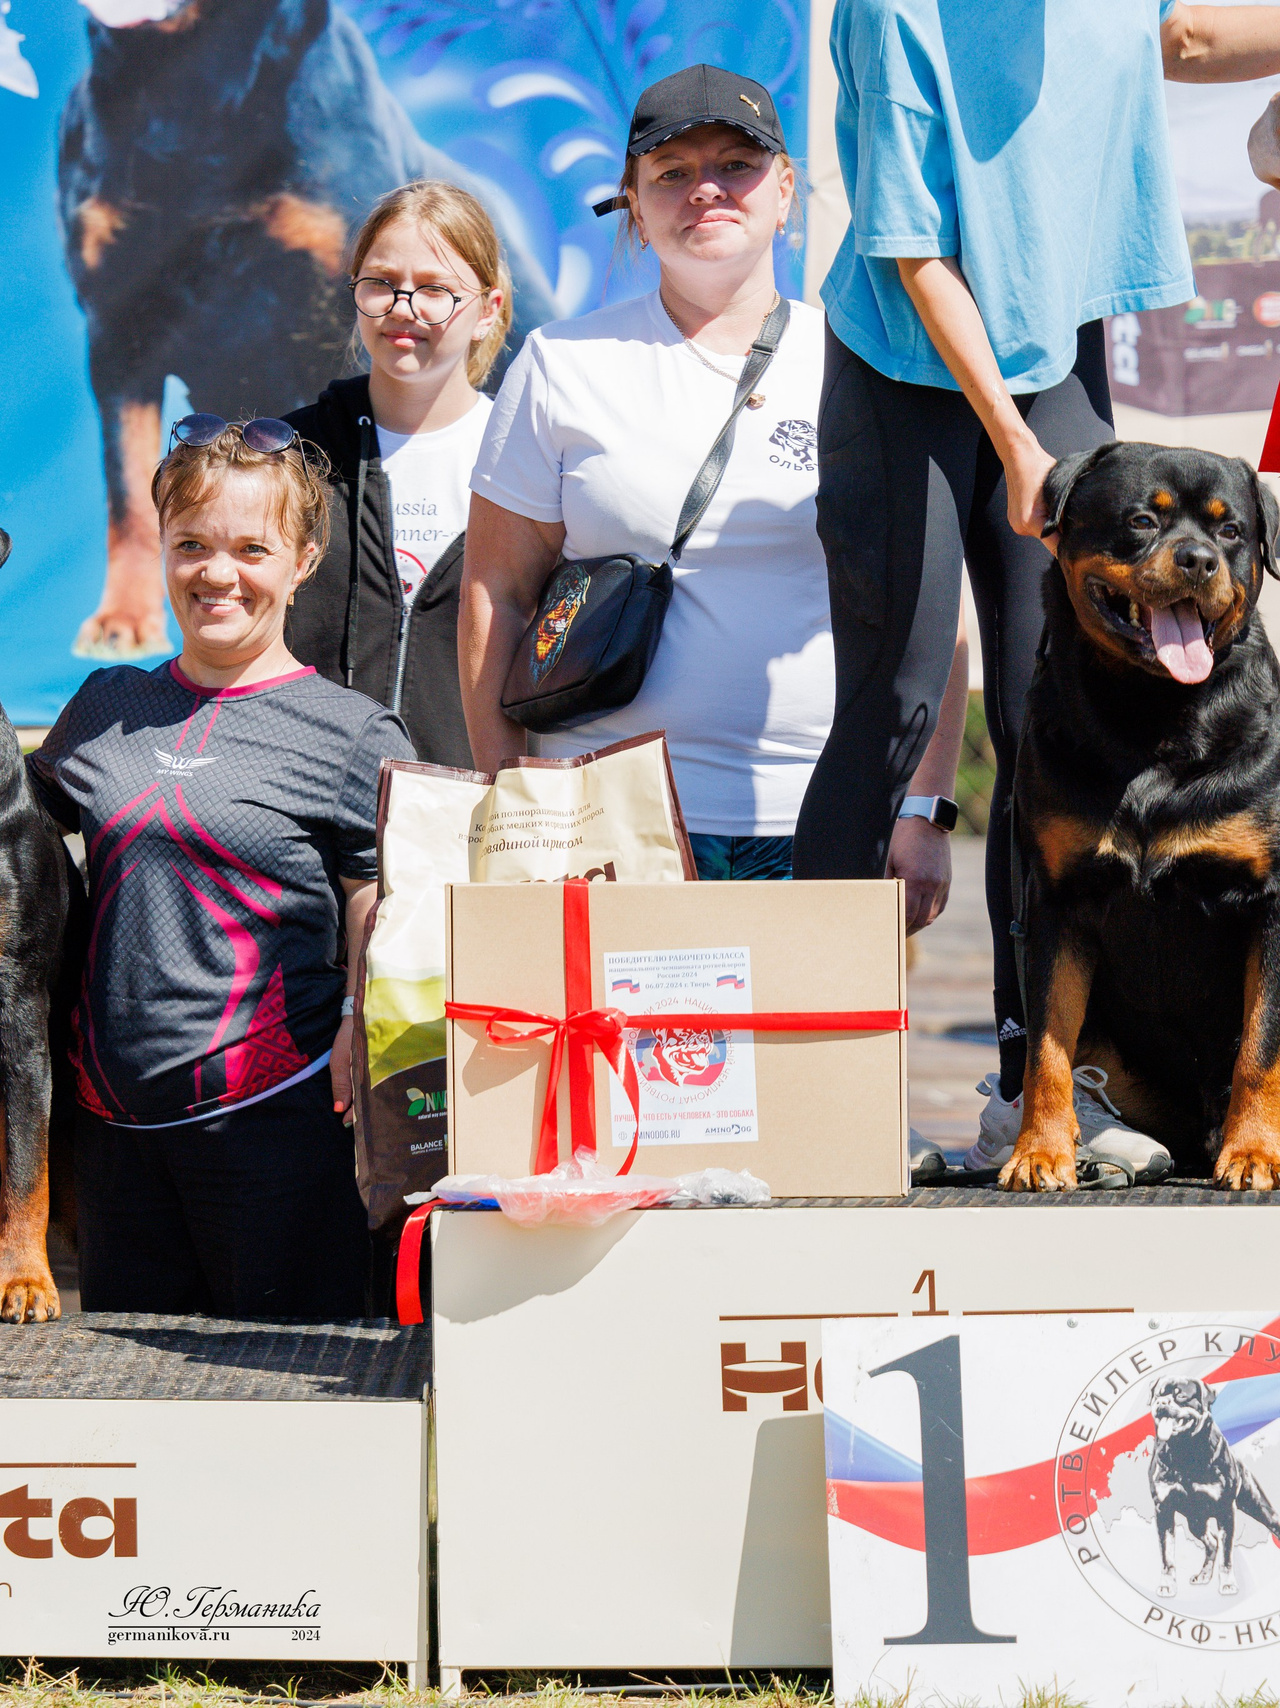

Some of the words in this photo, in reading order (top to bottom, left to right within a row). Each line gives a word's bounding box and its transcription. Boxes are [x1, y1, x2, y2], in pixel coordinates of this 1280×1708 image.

[769, 455, 818, 471] ОЛЬБ
[501, 806, 575, 819] полнорационный
[578, 802, 591, 814] для
[506, 820, 543, 831] мелких
[582, 807, 605, 823] пород
[550, 835, 583, 851] рисом
[608, 955, 667, 965] ПОБЕДИТЕЛЮ
[669, 953, 711, 962] РАБОЧЕГО
[713, 951, 745, 960] КЛАССА
[608, 965, 661, 973] национального
[645, 981, 683, 990] 06.07.2024
[690, 980, 711, 988] Тверь
[656, 996, 679, 1010] 2024
[643, 1112, 655, 1121] ЧТО
[657, 1112, 671, 1121] ЕСТЬ
[673, 1112, 678, 1121] У
[678, 1111, 711, 1120] ЧЕЛОВЕКА
[716, 1109, 728, 1118] ЭТО
[729, 1108, 754, 1118] СОБАКА
[410, 1139, 443, 1152] BALANCE
[912, 1269, 950, 1316] 1
[1061, 1339, 1178, 1567] РОТВЕЙЛЕР
[866, 1334, 1018, 1646] 1
